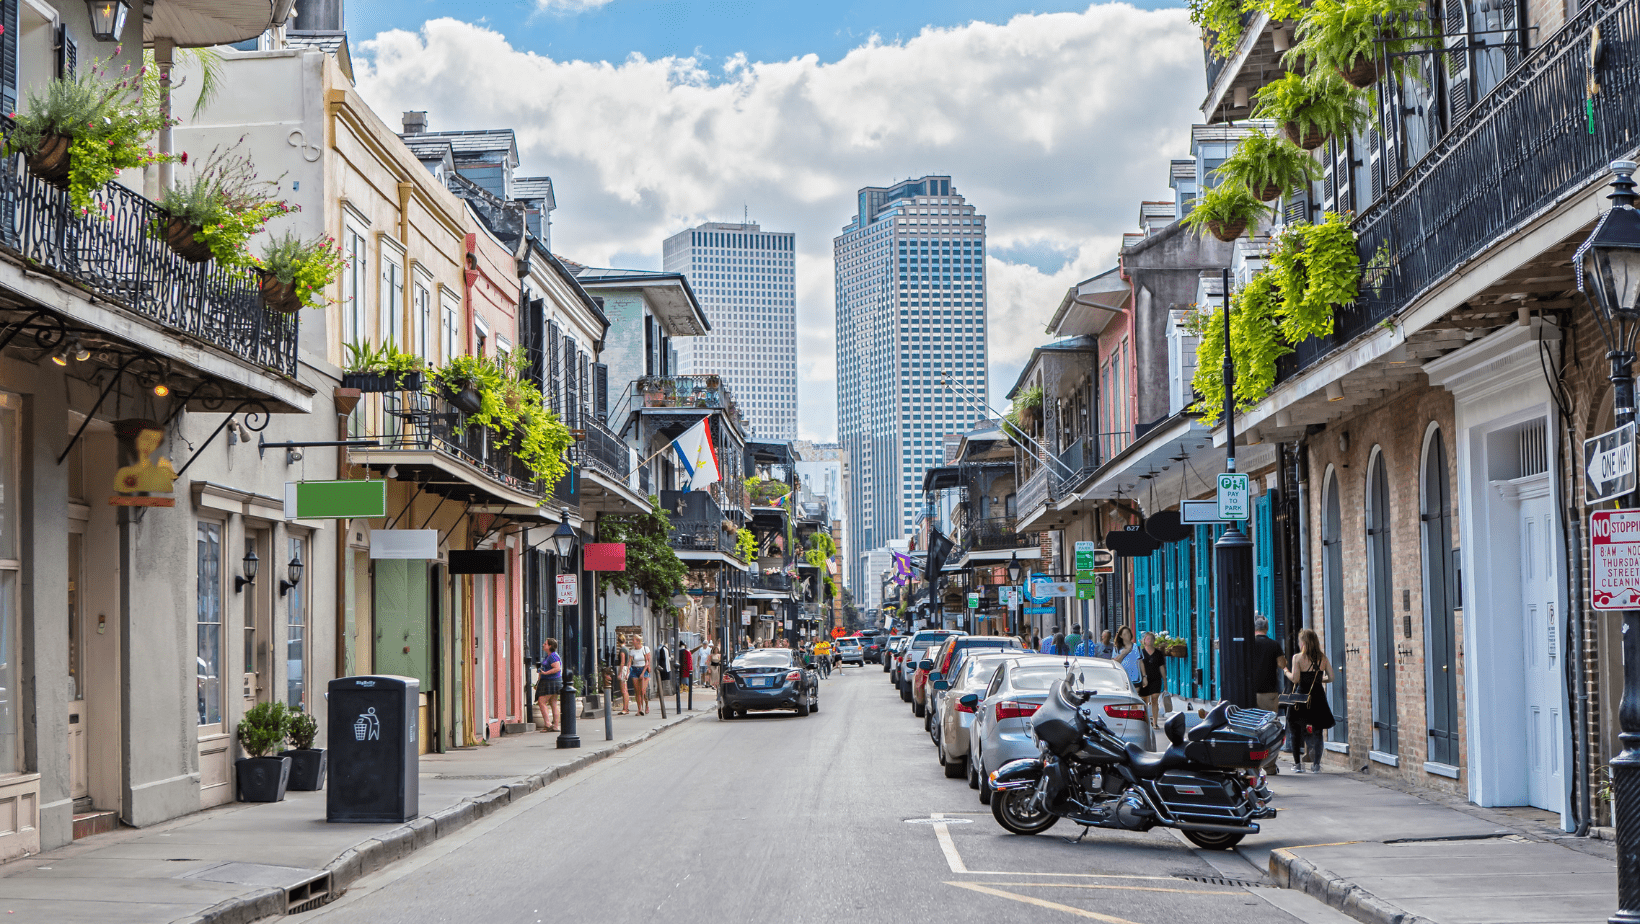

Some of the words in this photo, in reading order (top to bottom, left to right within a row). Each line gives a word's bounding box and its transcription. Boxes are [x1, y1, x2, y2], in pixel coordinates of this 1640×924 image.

[1602, 452, 1615, 478] ONE
[1618, 445, 1631, 474] WAY
[1593, 518, 1610, 538] NO
[1611, 520, 1640, 534] STOPPI
[1600, 546, 1617, 557] 8:AM
[1602, 557, 1640, 567] THURSDA
[1608, 567, 1640, 578] STREET
[1601, 577, 1640, 588] CLEANIN
